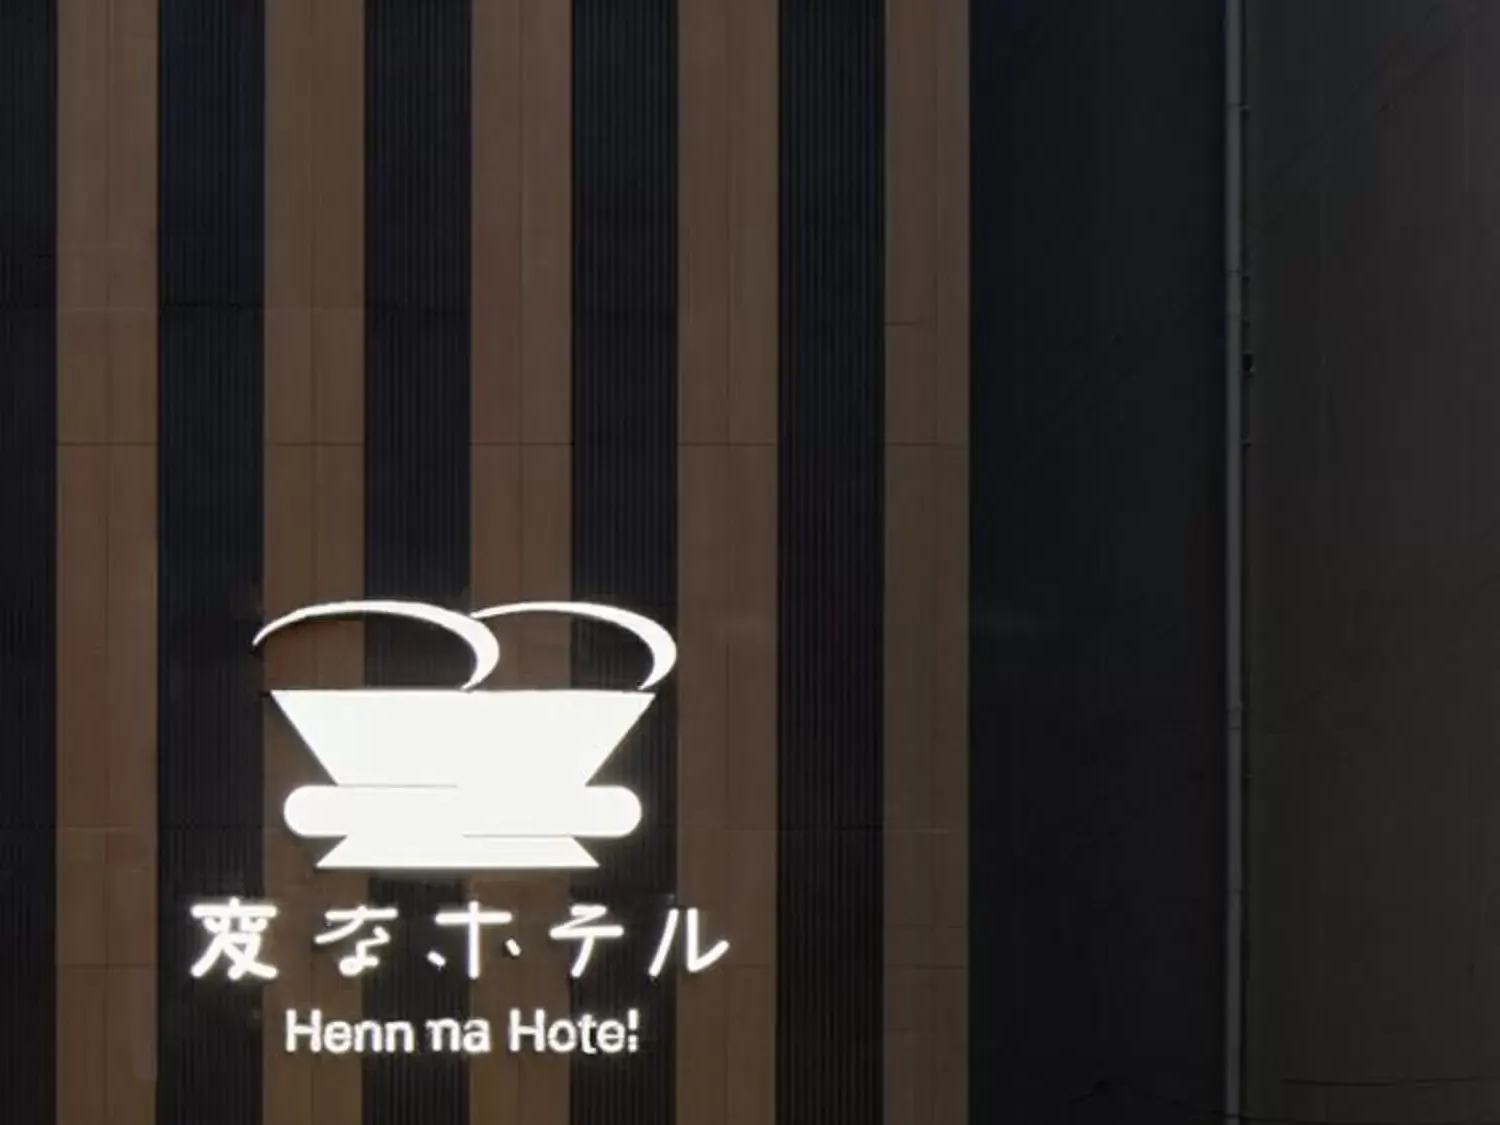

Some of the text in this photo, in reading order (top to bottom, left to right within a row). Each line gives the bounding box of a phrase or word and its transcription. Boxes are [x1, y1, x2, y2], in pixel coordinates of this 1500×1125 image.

[190, 897, 730, 981] 変なホテル
[284, 1008, 640, 1054] Henn na Hotel
